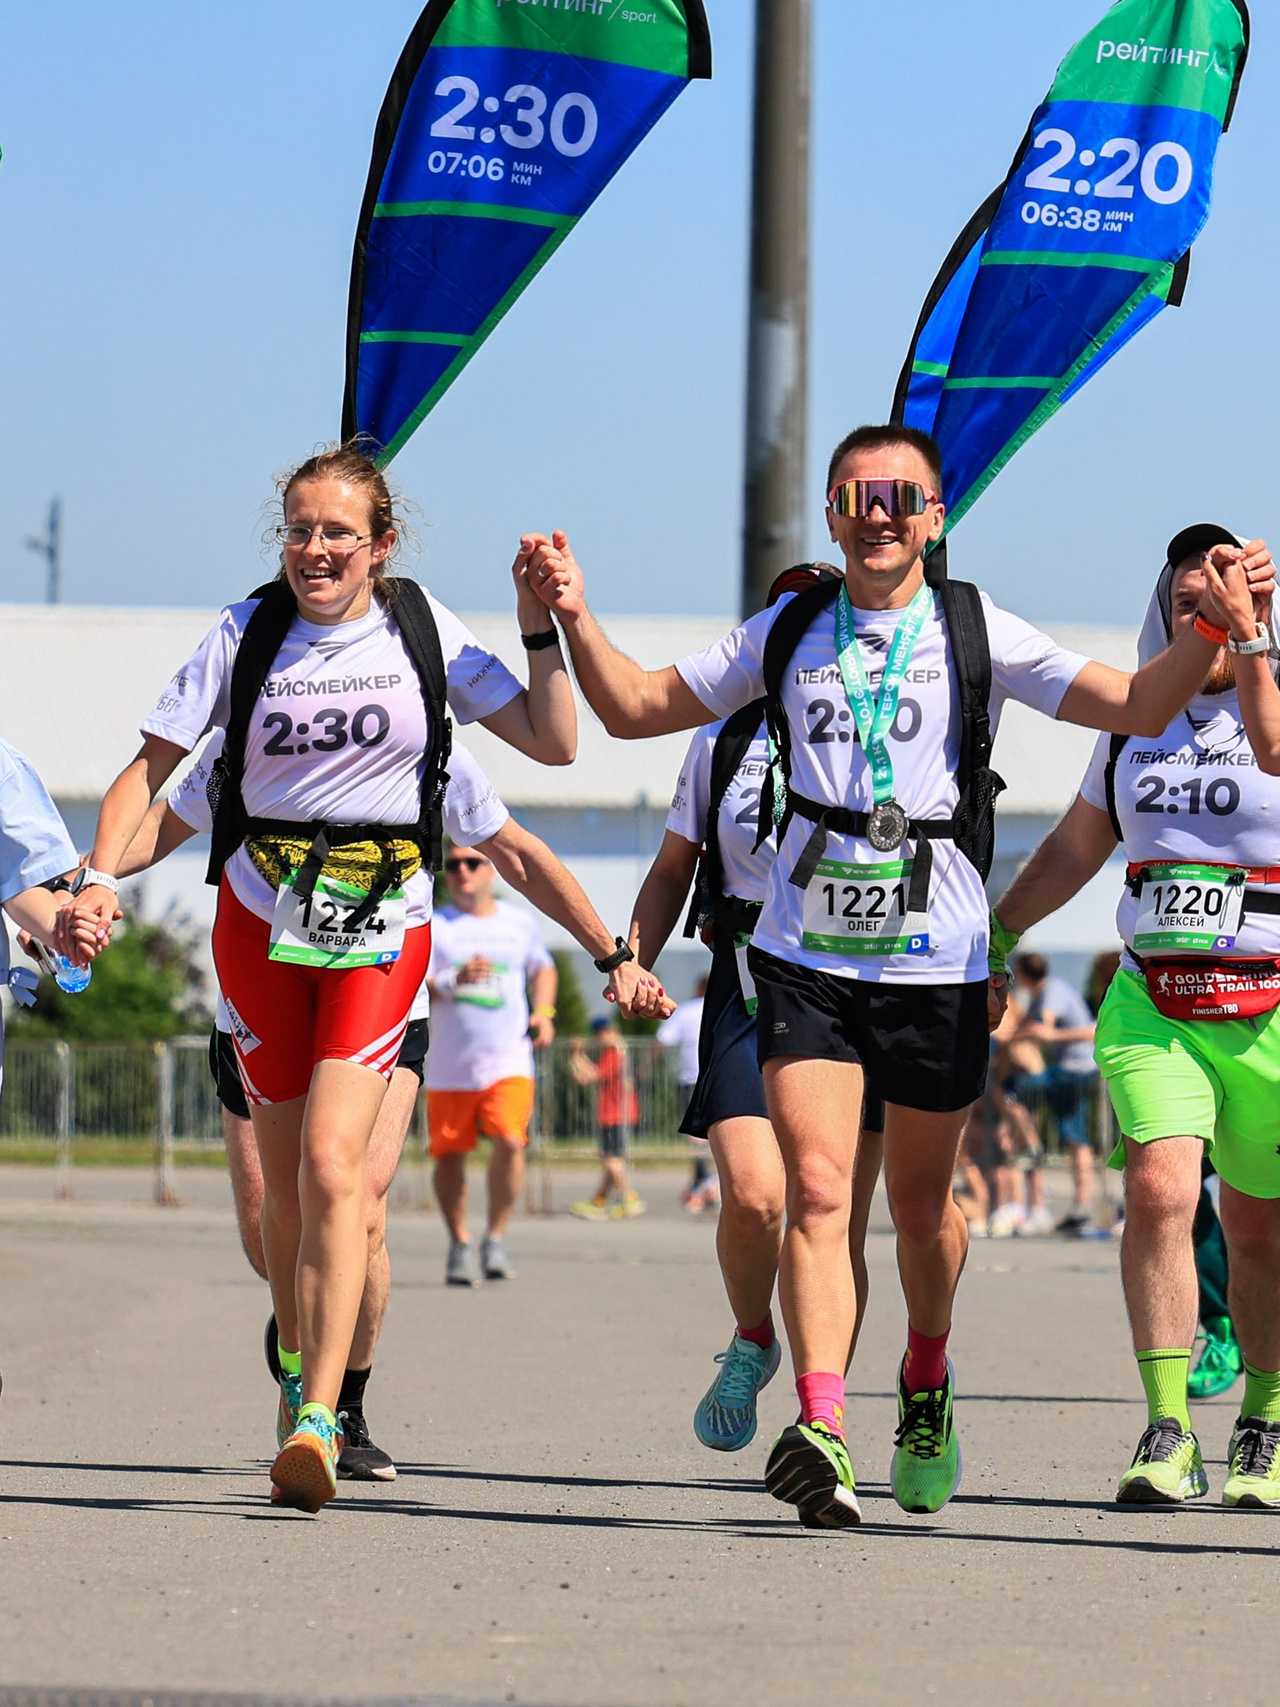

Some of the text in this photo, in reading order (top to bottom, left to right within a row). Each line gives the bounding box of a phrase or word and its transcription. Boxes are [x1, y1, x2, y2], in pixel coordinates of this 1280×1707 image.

[621, 9, 658, 24] sport
[1095, 37, 1210, 68] рейтинг
[430, 75, 598, 158] 2:30
[427, 150, 505, 181] 07:06
[1024, 128, 1194, 206] 2:20
[1021, 200, 1102, 232] 06:38
[262, 703, 390, 756] 2:30
[807, 698, 923, 744] 2:0
[1135, 775, 1240, 816] 2:10
[299, 896, 387, 935] 1224
[822, 882, 906, 918] 1221
[1153, 884, 1224, 917] 1220
[847, 920, 881, 932] ОЛЕГ
[1157, 916, 1205, 927] АЛЕКСЕЙ
[308, 932, 367, 947] ВАРВАРА
[1174, 972, 1238, 984] GOLDEN
[1174, 979, 1280, 995] ULTRA TRAIL 100
